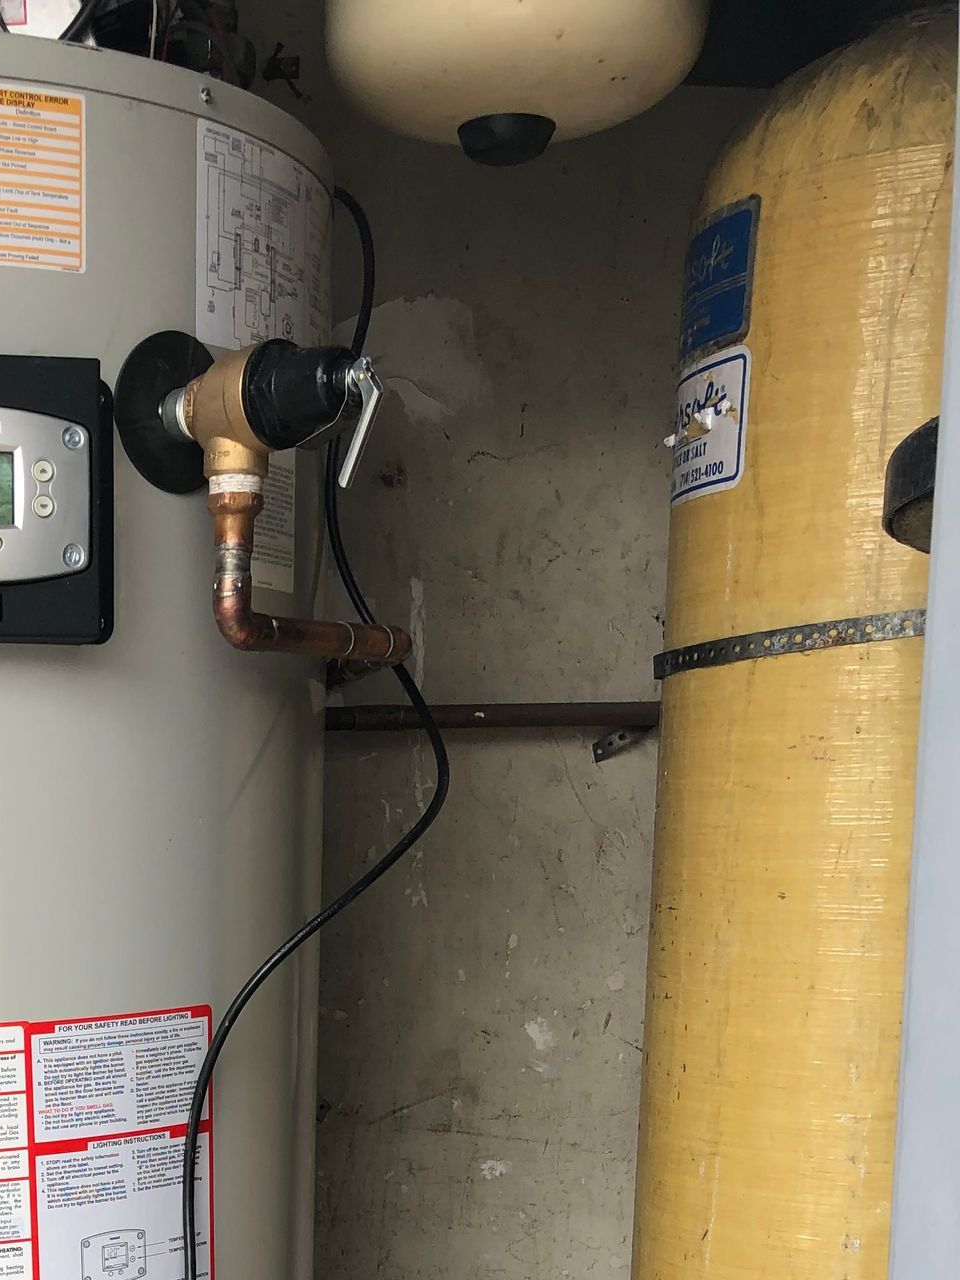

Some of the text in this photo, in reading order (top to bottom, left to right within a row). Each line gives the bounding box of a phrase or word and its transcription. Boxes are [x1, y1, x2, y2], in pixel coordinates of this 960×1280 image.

[6, 99, 35, 108] DISPLAY
[10, 92, 42, 102] CONTROL
[45, 95, 69, 105] ERROR
[690, 442, 707, 459] SALT
[690, 461, 724, 484] 521-4100
[94, 1022, 119, 1030] SAFETY
[120, 1019, 137, 1027] READ
[138, 1017, 162, 1025] BEFORE
[163, 1013, 189, 1022] LIGHTING
[93, 1133, 166, 1149] LIGHTING INSTRUCTIONS
